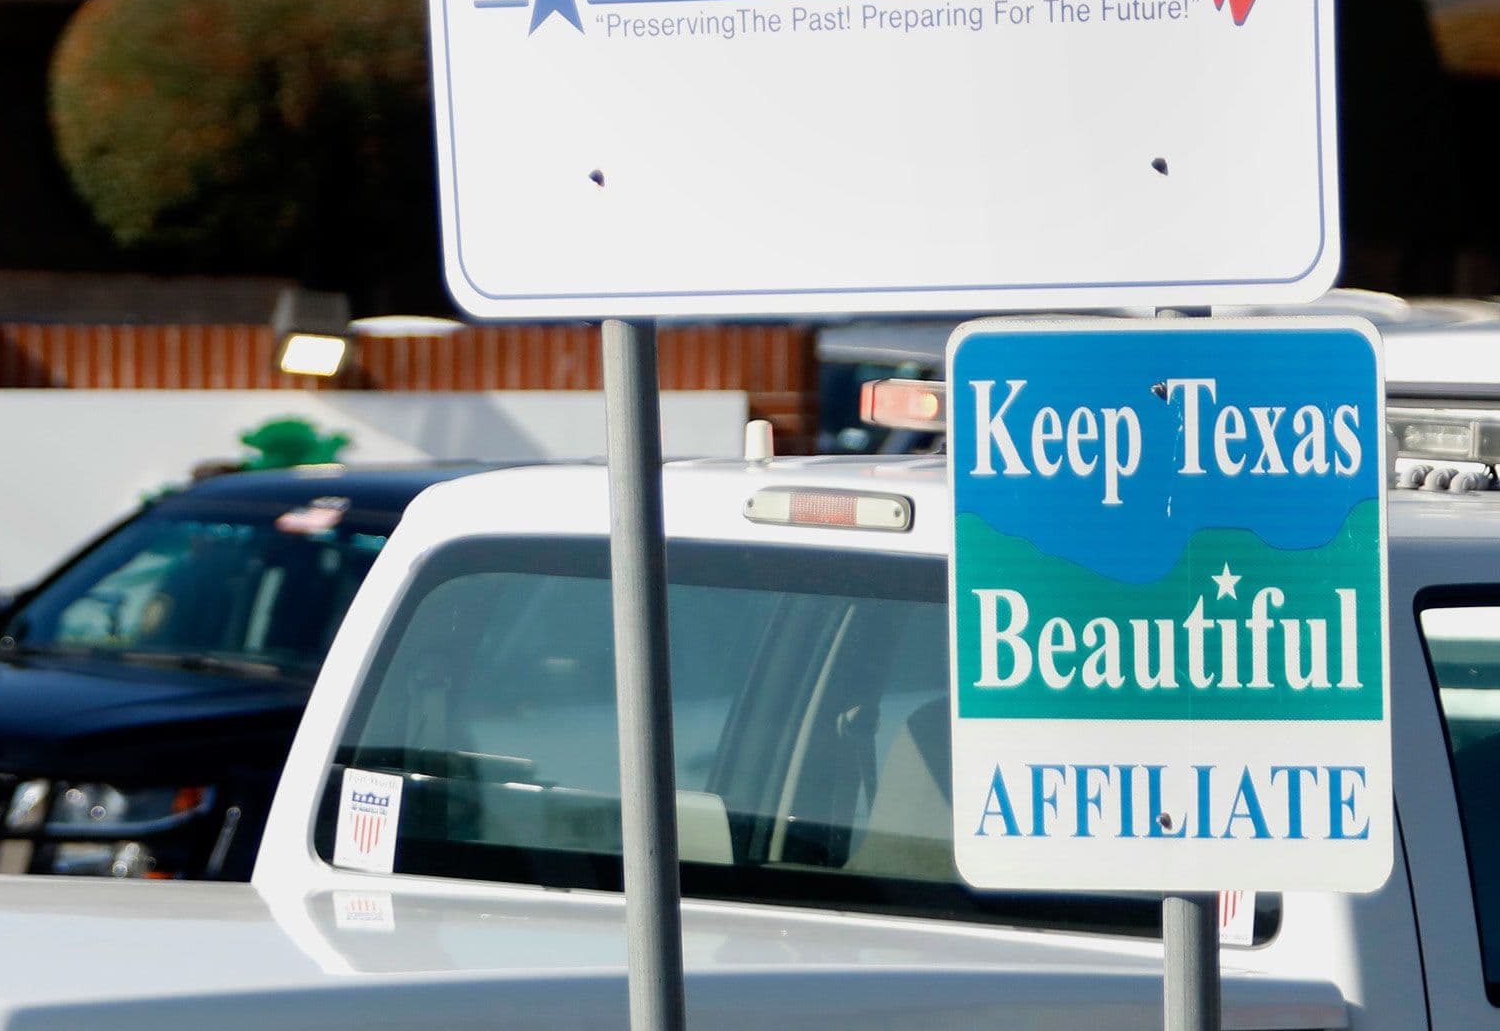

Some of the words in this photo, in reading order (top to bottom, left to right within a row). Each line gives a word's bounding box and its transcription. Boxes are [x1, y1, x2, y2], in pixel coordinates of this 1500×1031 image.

[792, 5, 851, 32] Past!
[862, 2, 983, 32] Preparing
[994, 0, 1035, 25] For
[969, 379, 1142, 505] Keep
[1166, 378, 1363, 476] Texas
[972, 581, 1364, 691] Beautiful
[974, 763, 1371, 841] AFFILIATE
